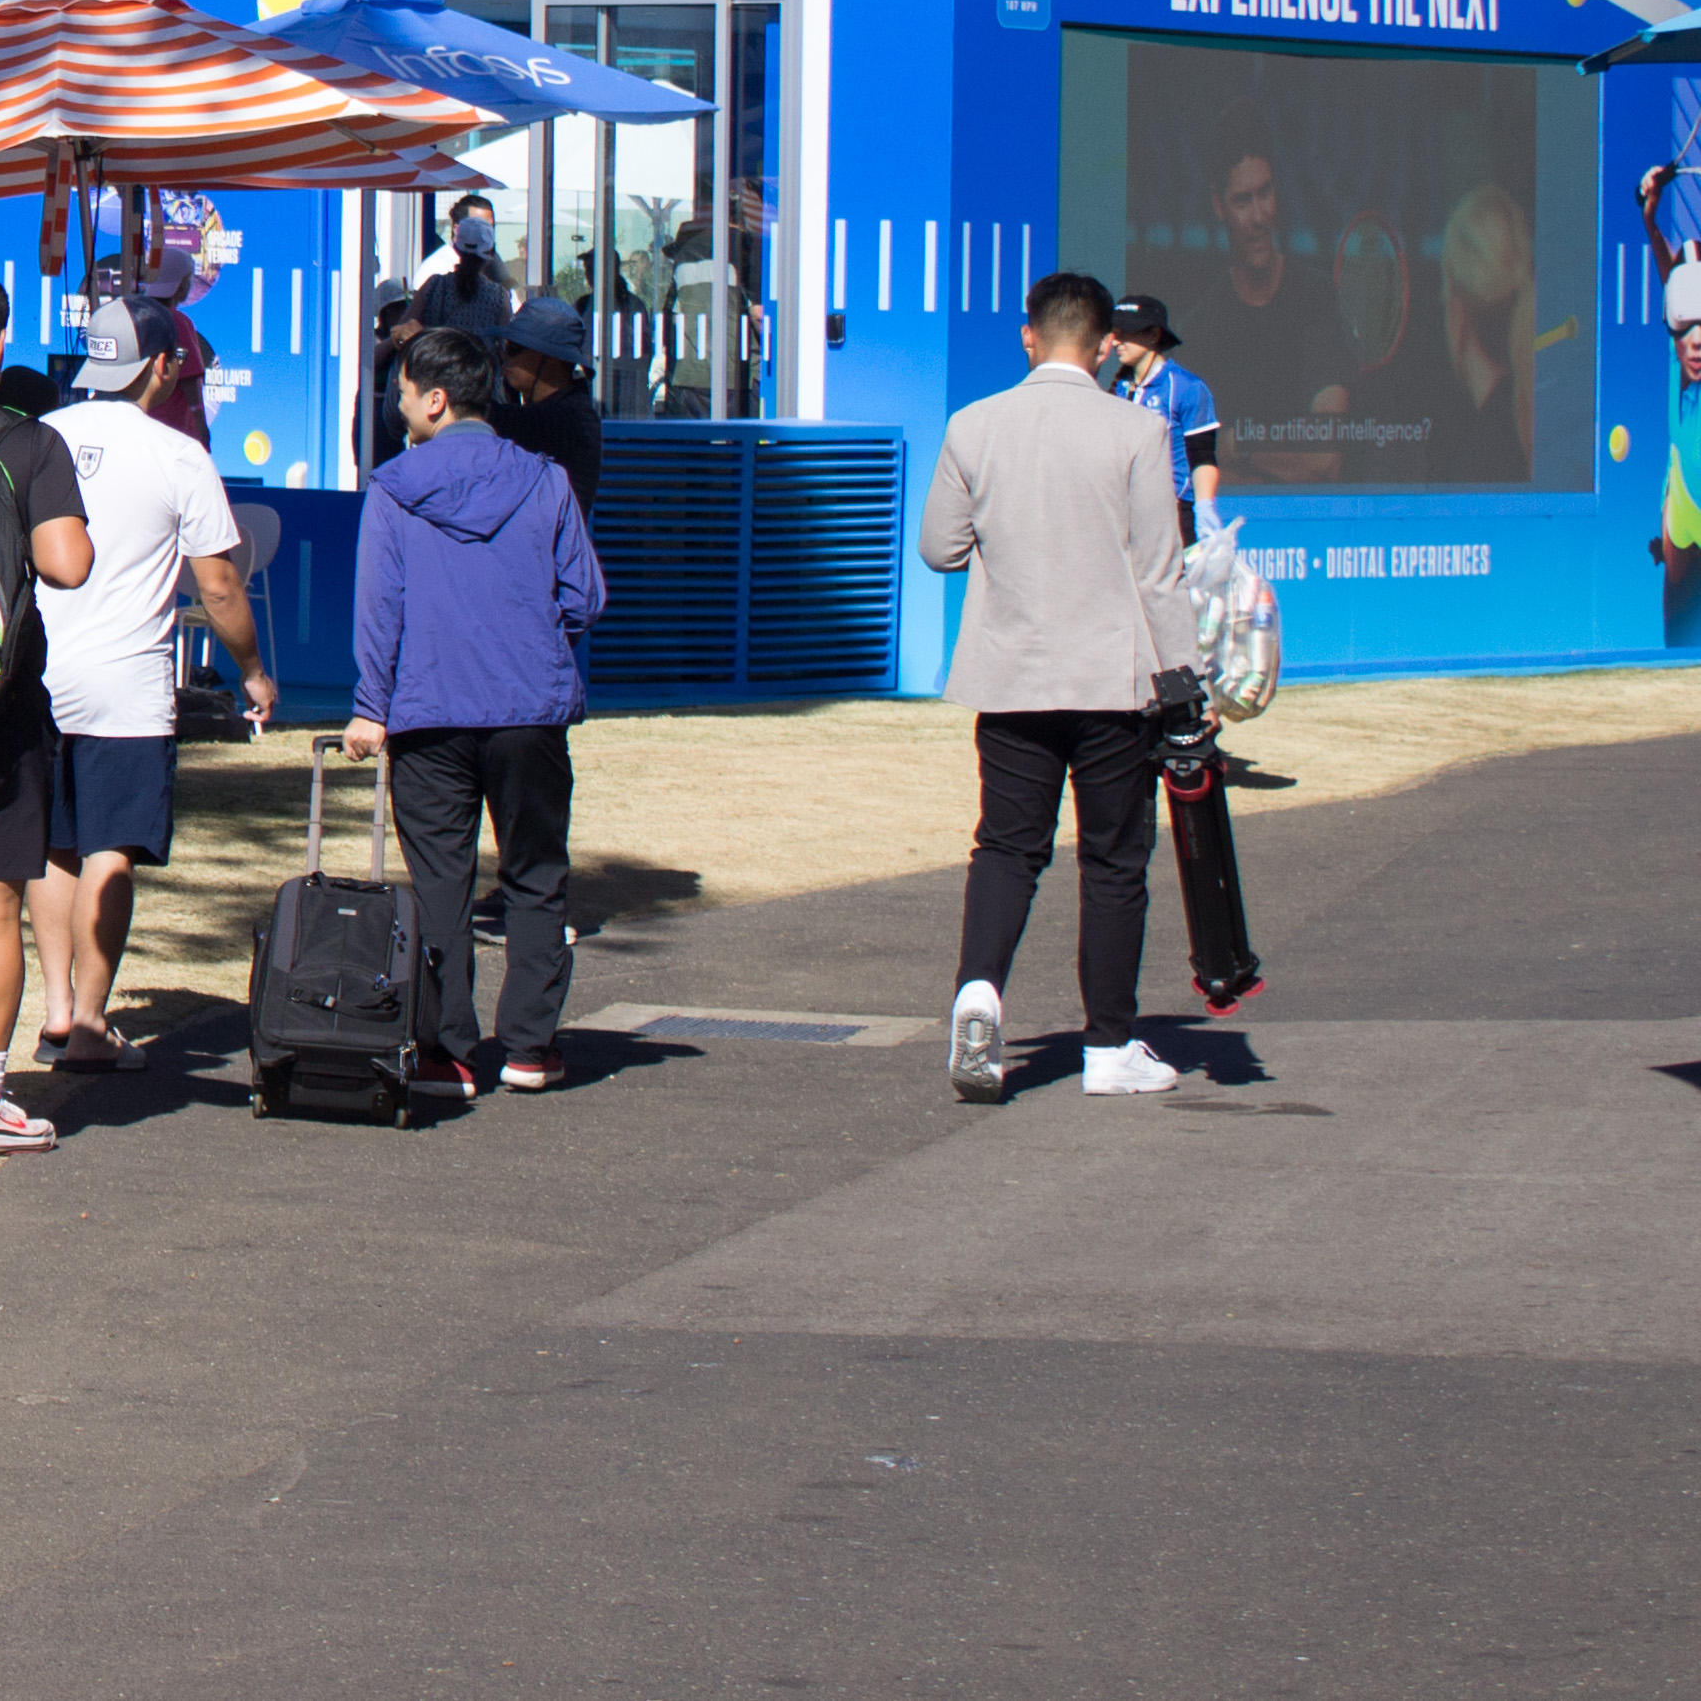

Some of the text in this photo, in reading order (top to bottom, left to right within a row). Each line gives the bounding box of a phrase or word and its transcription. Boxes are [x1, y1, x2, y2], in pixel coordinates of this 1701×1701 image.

[372, 45, 571, 88] Infosys
[206, 230, 244, 249] ARCADE
[206, 247, 240, 265] TENNIS
[205, 369, 252, 386] ROD LAVER
[205, 385, 237, 403] TENNIS
[1236, 417, 1433, 448] Like artificial intelligence?
[1237, 545, 1491, 580] NSIGHTS DIGITAL EXPERIENCES
